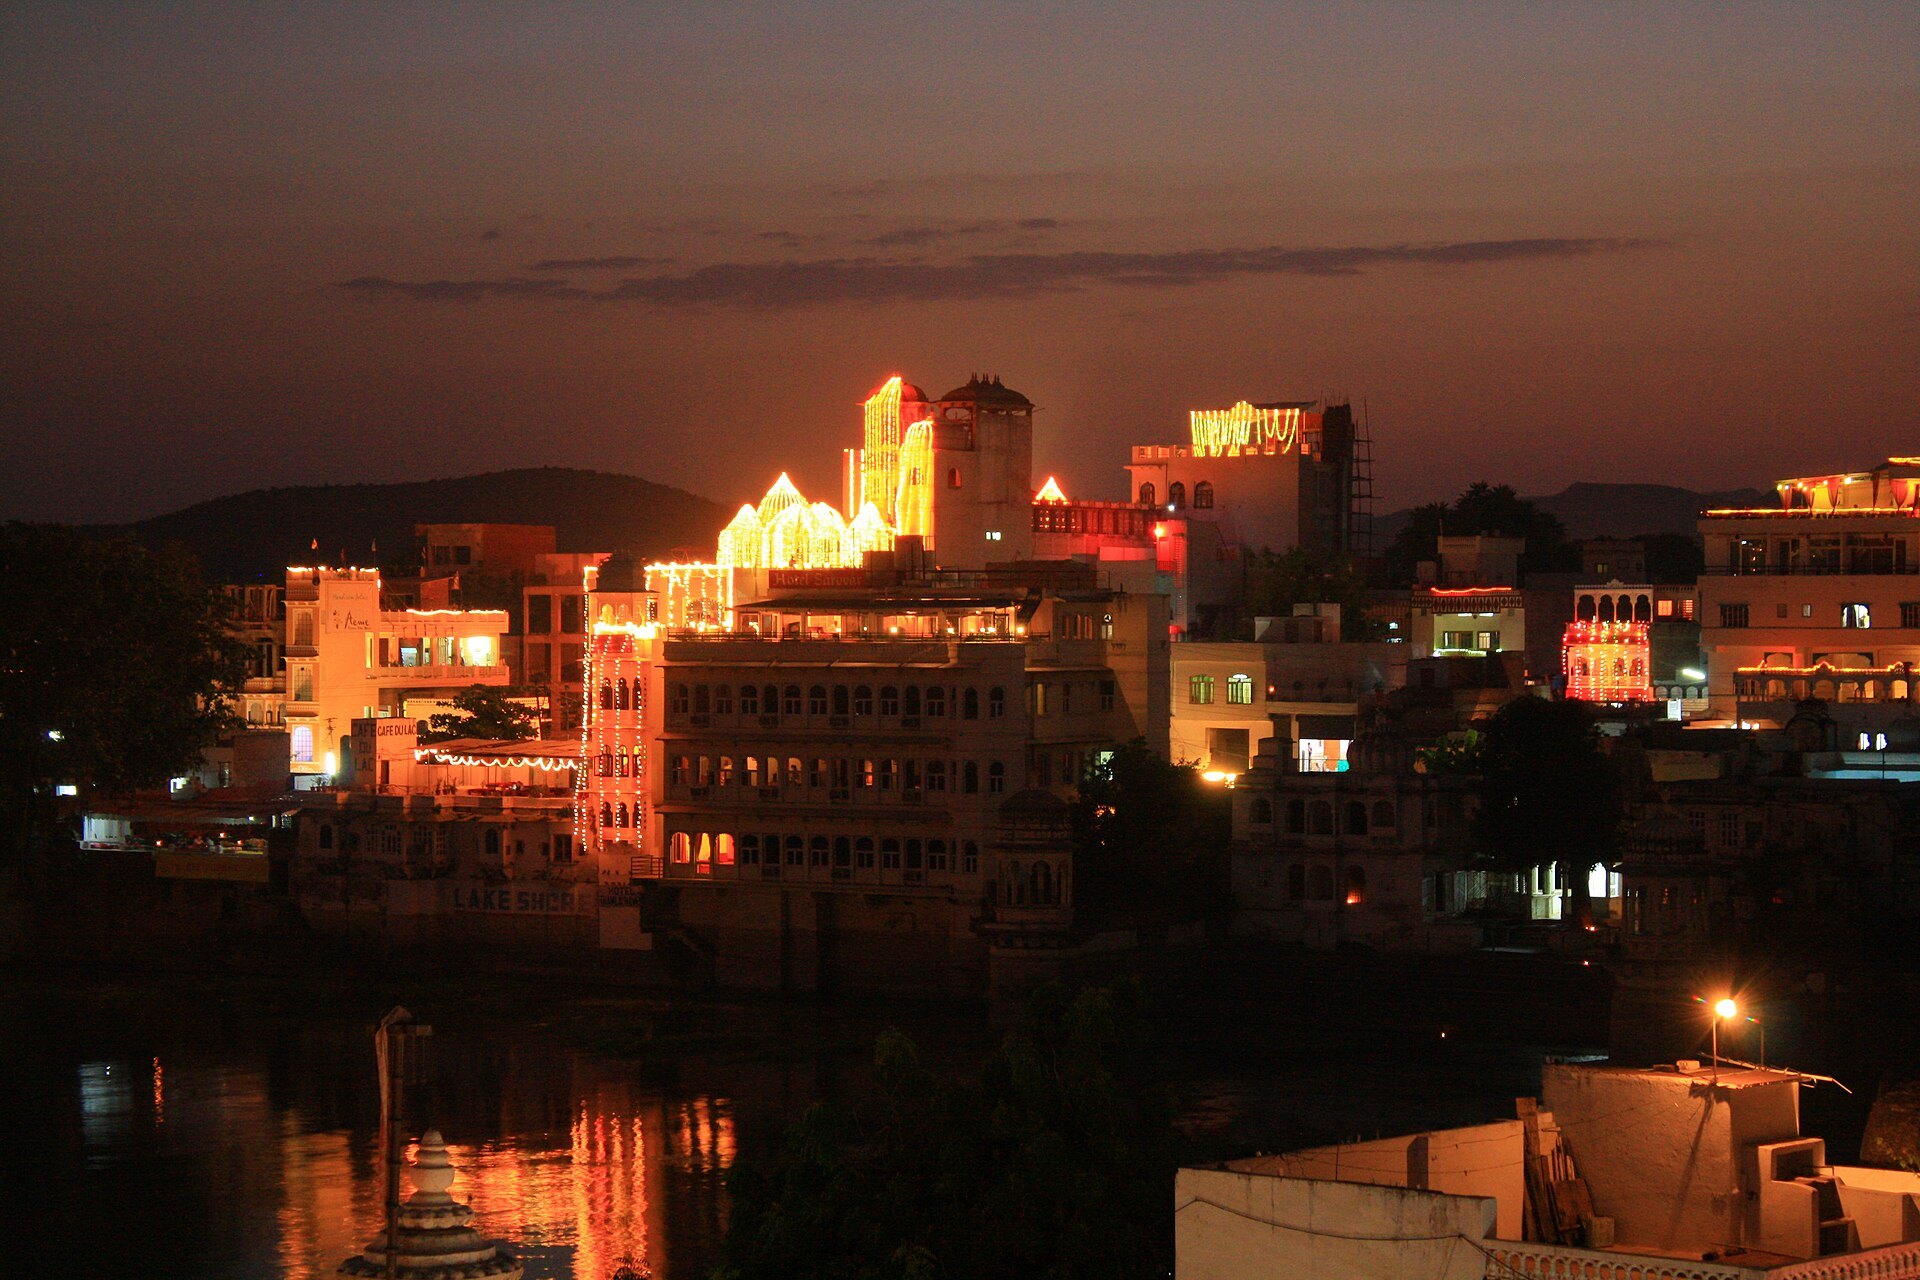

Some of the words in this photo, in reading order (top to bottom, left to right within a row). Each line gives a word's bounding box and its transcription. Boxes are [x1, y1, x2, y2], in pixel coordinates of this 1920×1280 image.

[774, 572, 810, 586] Hotel
[377, 725, 393, 737] CAFE
[394, 724, 404, 736] DU
[404, 723, 417, 736] LAC
[354, 757, 374, 772] LAC
[453, 887, 511, 911] LAKE
